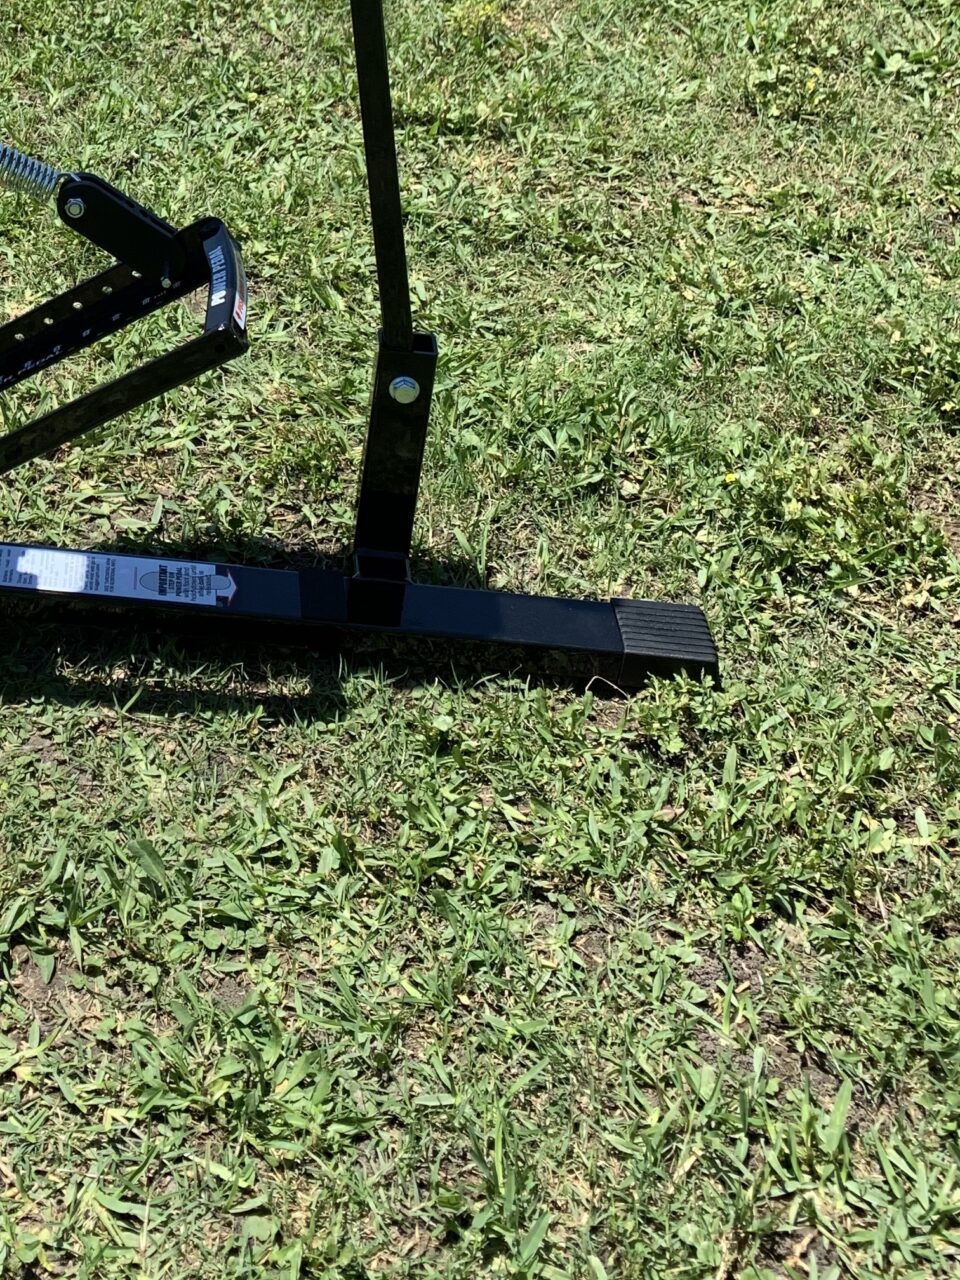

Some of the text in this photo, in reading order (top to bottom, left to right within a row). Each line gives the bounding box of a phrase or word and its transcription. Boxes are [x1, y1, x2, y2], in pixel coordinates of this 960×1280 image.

[208, 245, 227, 306] POWER PEDAL
[158, 564, 168, 596] IMPORTANT
